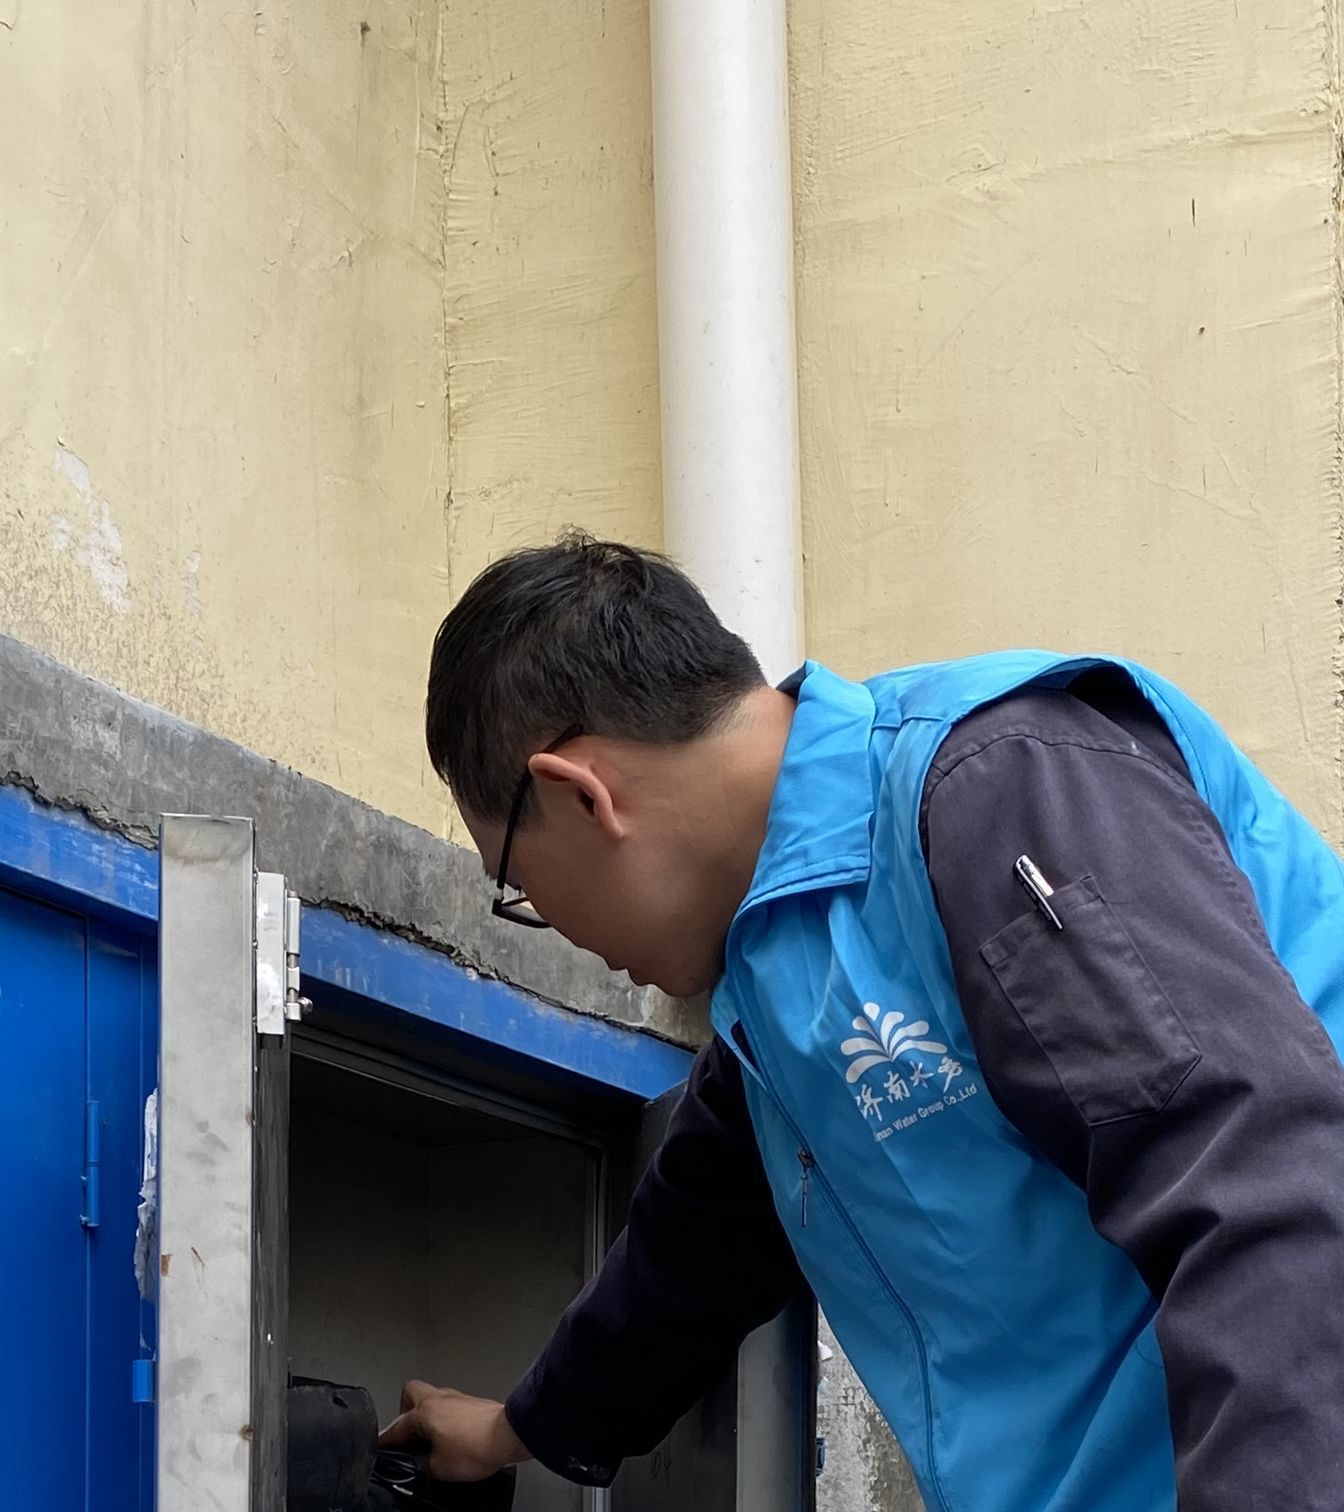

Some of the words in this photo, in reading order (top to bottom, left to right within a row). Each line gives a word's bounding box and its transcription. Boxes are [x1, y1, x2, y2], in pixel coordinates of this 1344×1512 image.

[855, 1056, 964, 1122] 济南水务
[892, 1113, 918, 1131] Water
[917, 1101, 944, 1119] Group
